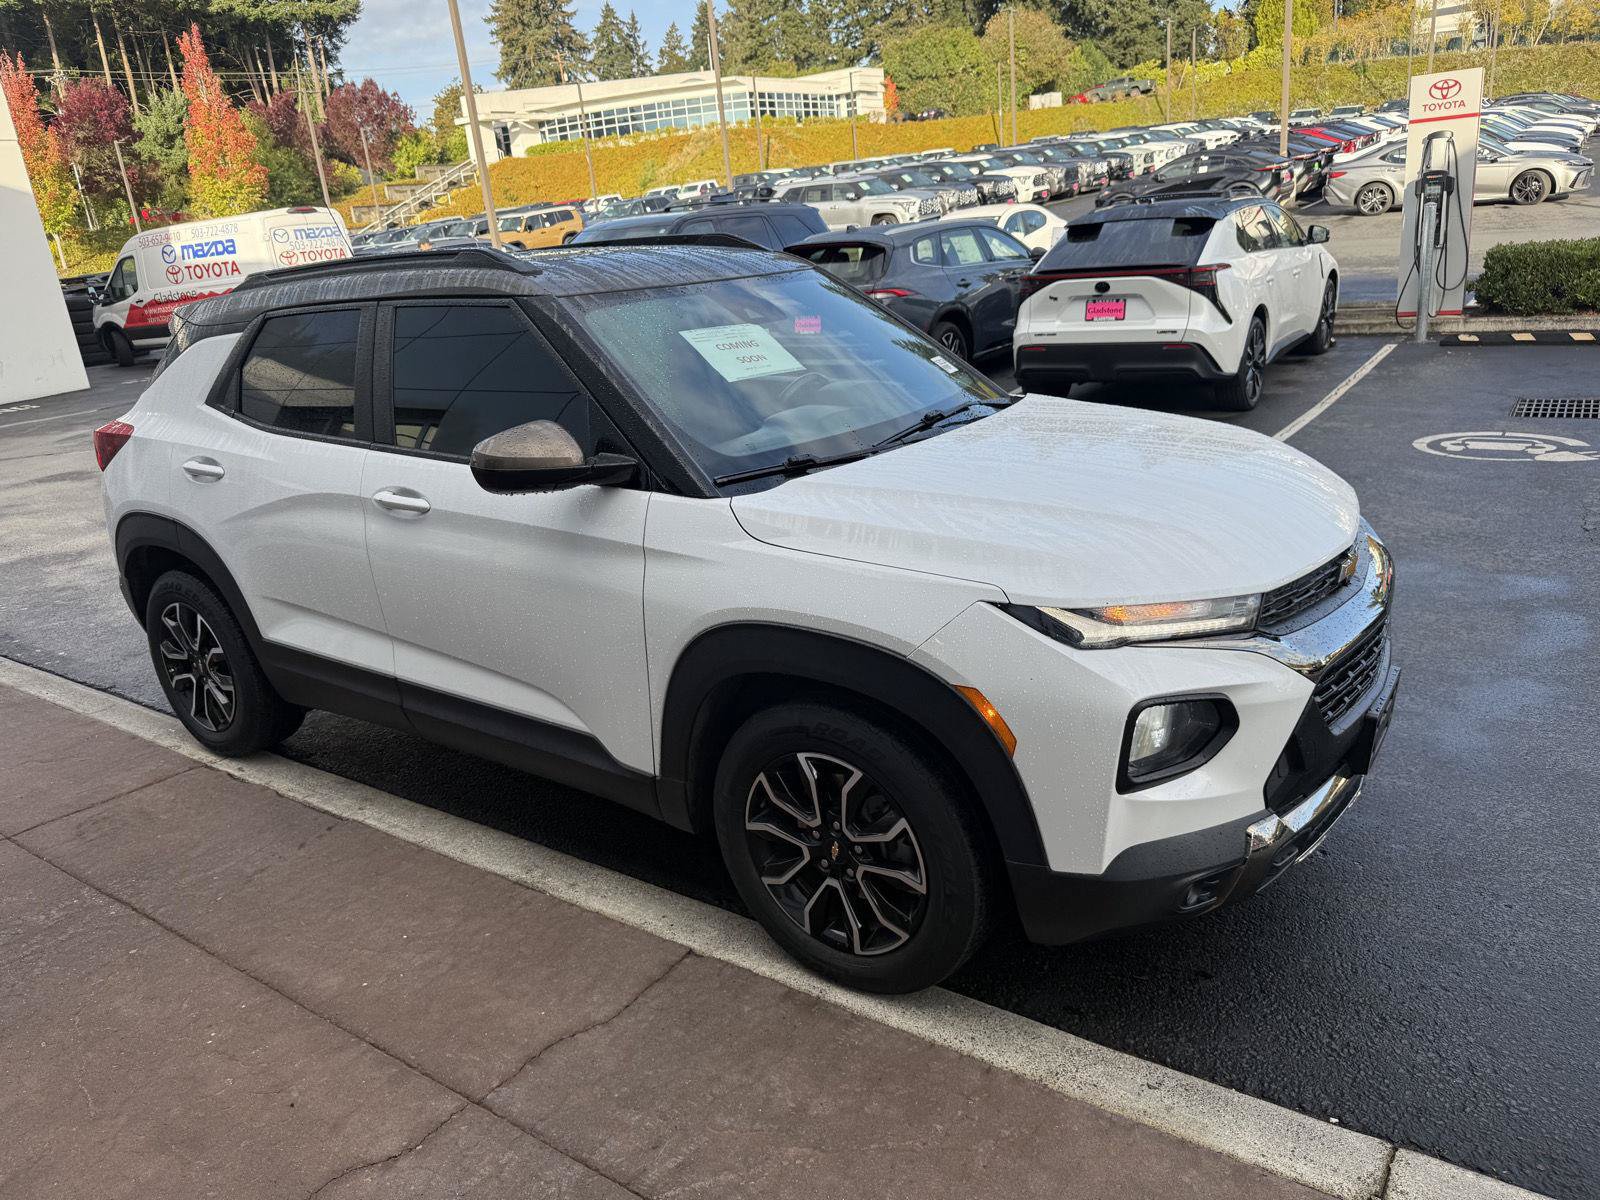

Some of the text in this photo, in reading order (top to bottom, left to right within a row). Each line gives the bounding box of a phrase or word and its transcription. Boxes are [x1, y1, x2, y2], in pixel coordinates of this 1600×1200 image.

[1422, 100, 1466, 112] TOYOTA
[191, 223, 239, 239] 503-722-4878
[139, 231, 181, 248] 503-652-910
[300, 248, 347, 262] TOYOTA
[185, 260, 242, 280] TOYOTA
[154, 290, 196, 304] Gladstone
[715, 339, 760, 351] COMING
[735, 354, 768, 364] SOON
